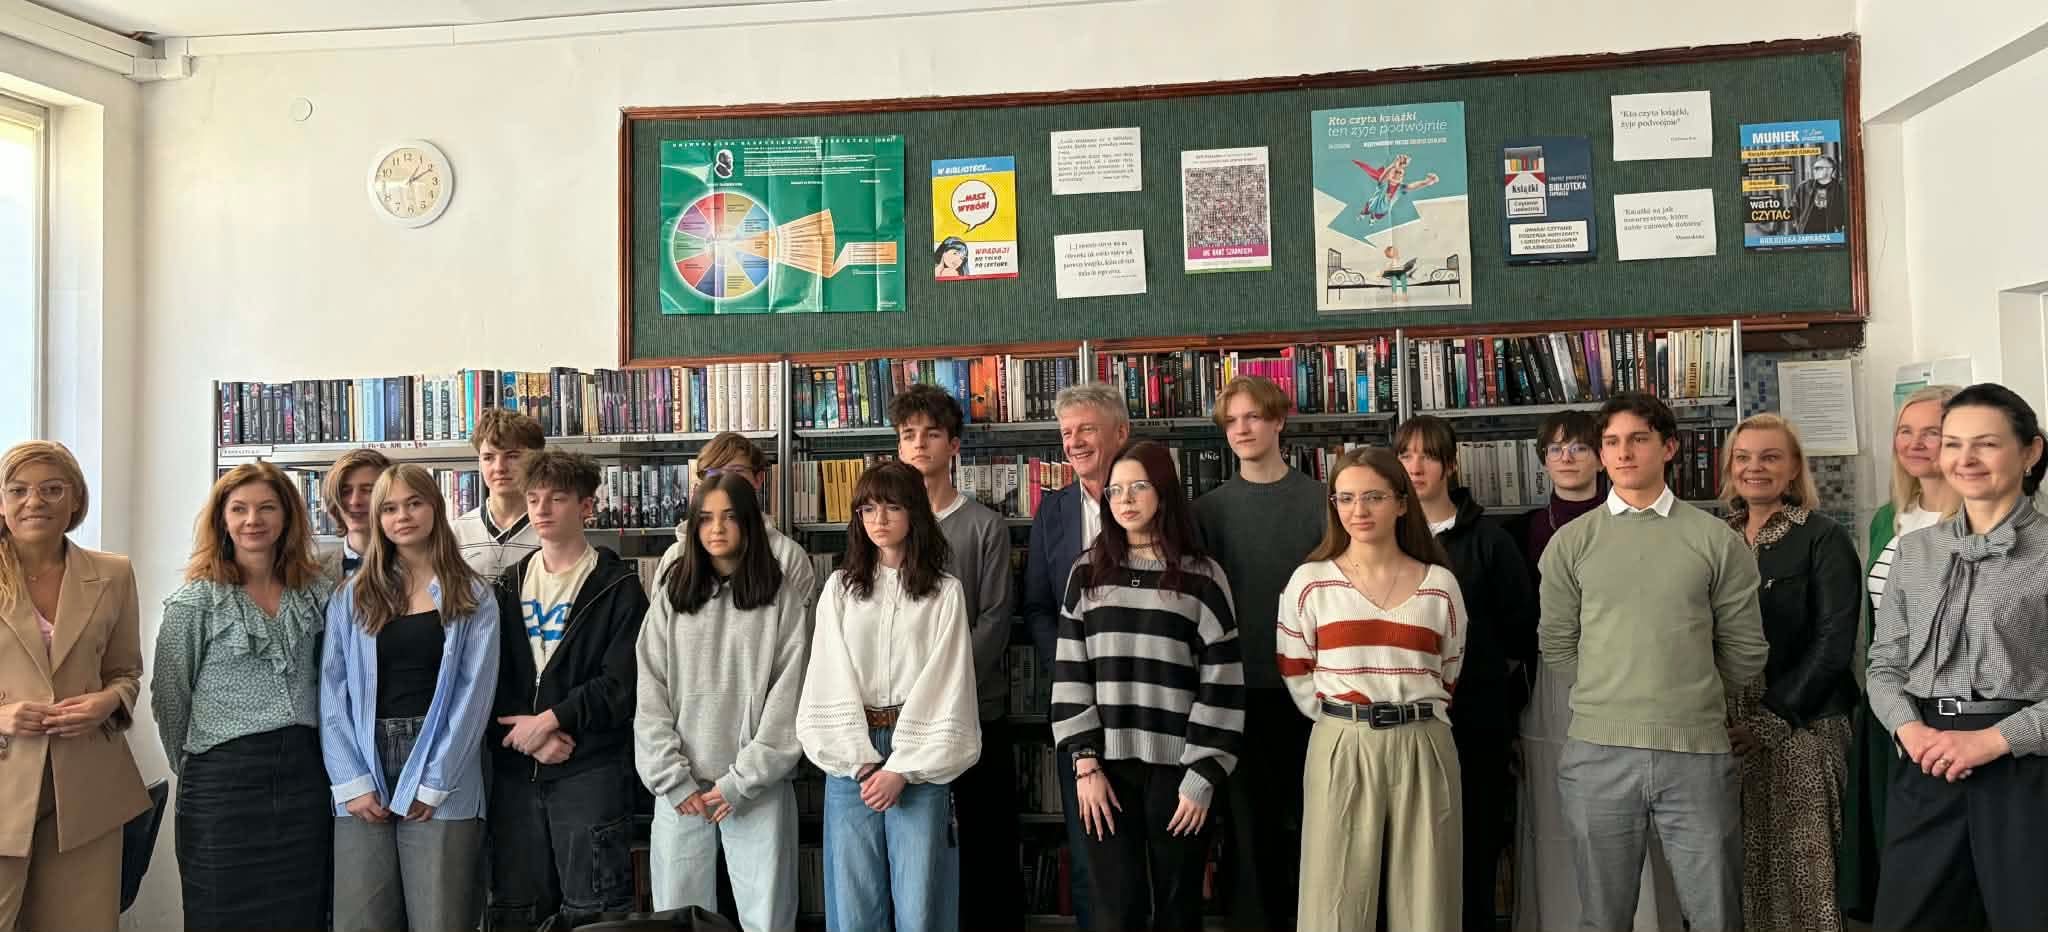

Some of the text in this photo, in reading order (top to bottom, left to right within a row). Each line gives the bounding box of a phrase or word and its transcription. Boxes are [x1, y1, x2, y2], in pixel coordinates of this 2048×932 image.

[1328, 112, 1416, 126] Kto czyta książki
[1638, 110, 1659, 119] czyta
[1328, 126, 1348, 137] ten
[1379, 120, 1448, 135] podwójnie
[1620, 119, 1637, 129] żyje
[1752, 130, 1800, 144] MUNIEK
[403, 152, 412, 161] 12
[392, 157, 400, 166] 11
[383, 169, 392, 177] 10
[937, 167, 945, 175] W
[432, 176, 439, 186] 3
[1512, 183, 1539, 194] Książki
[1549, 182, 1587, 191] BIBLIOTEKA
[420, 200, 426, 209] 5
[957, 201, 990, 212] WYBÓR!
[1750, 199, 1780, 209] warto
[407, 206, 415, 214] 6
[1662, 205, 1674, 214] jak
[1759, 234, 1831, 244] BIBLIOTEKA ZAPRASZA
